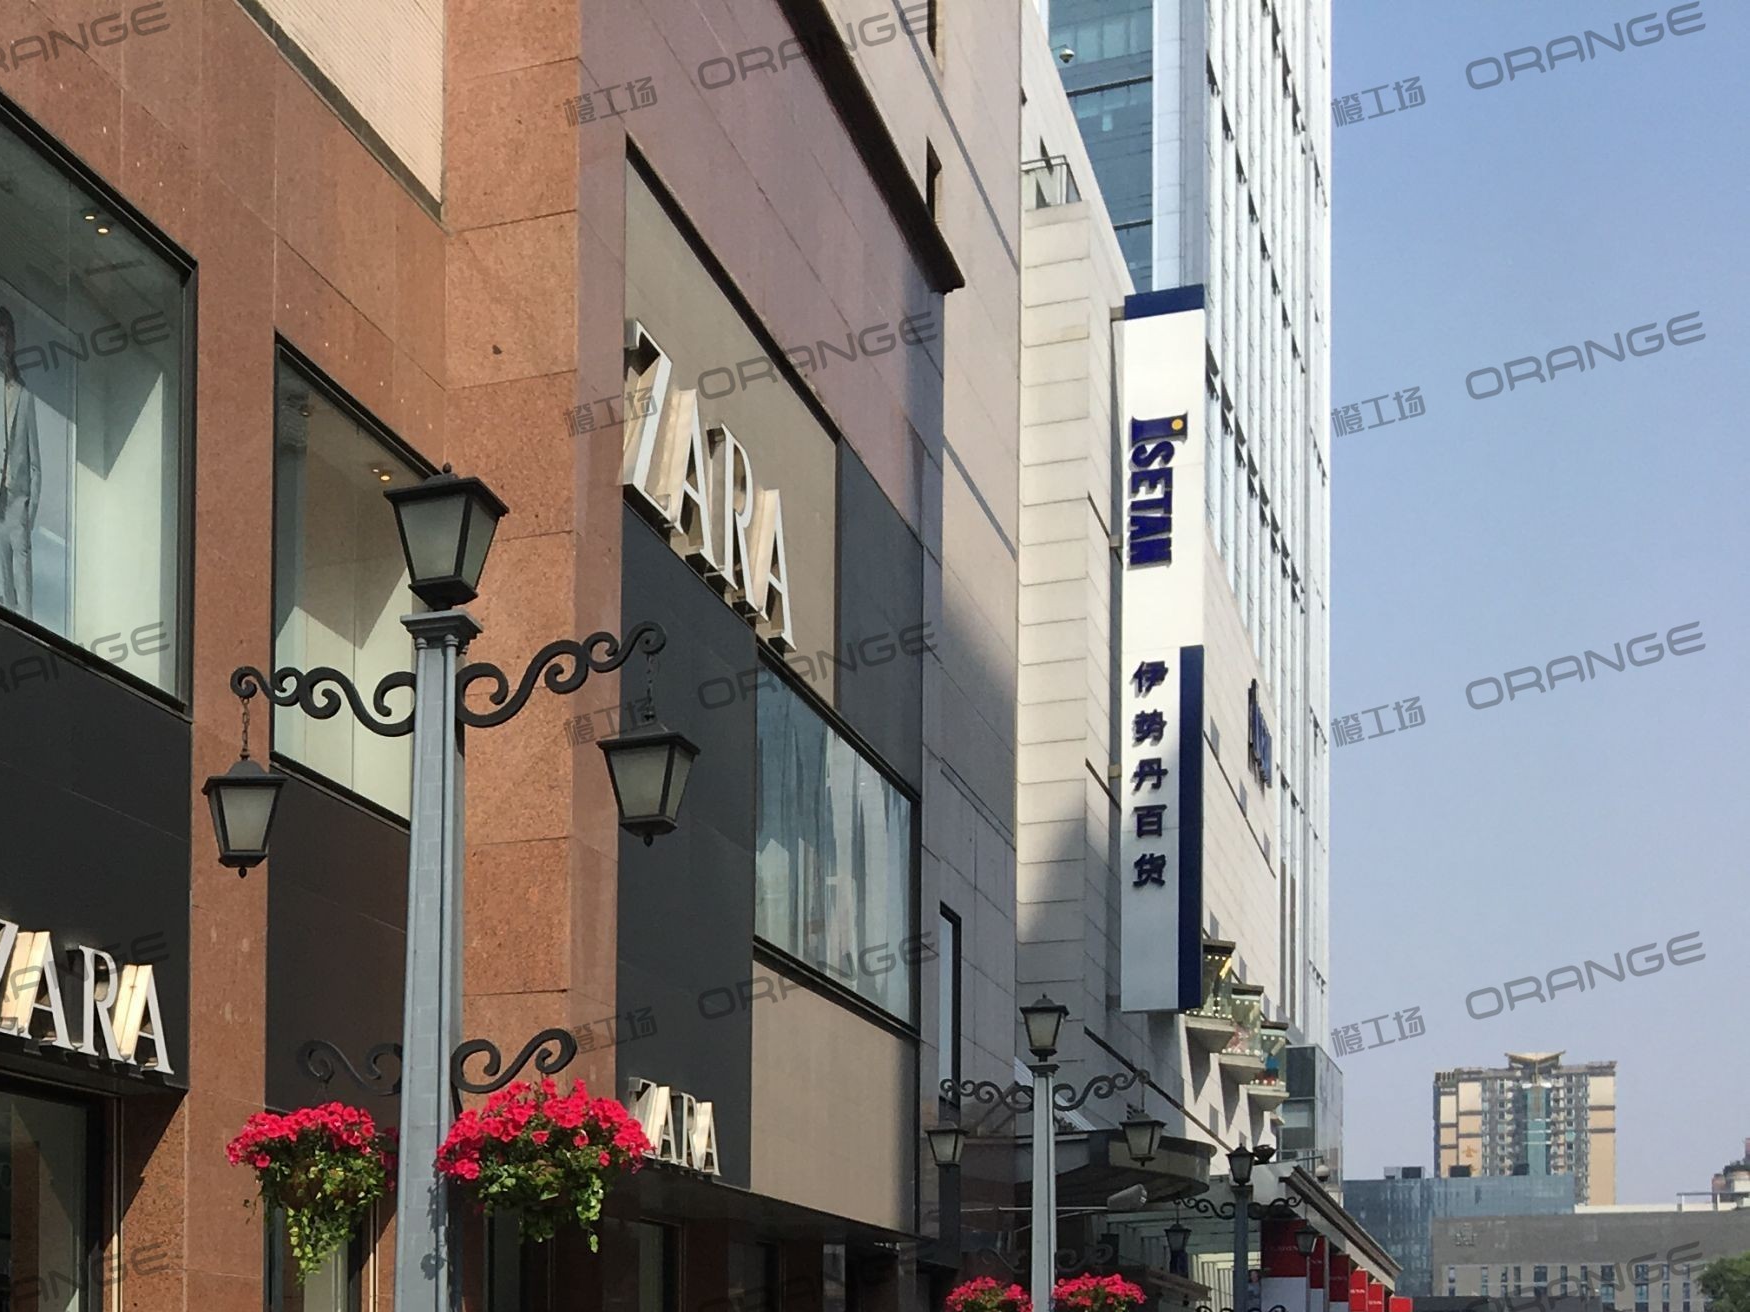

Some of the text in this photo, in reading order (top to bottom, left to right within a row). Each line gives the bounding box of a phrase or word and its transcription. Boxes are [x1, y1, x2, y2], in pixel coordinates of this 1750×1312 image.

[622, 318, 797, 652] ZARA
[1129, 411, 1188, 567] ISETAN
[1133, 661, 1168, 888] 伊势丹百货
[629, 1077, 722, 1177] ZARA
